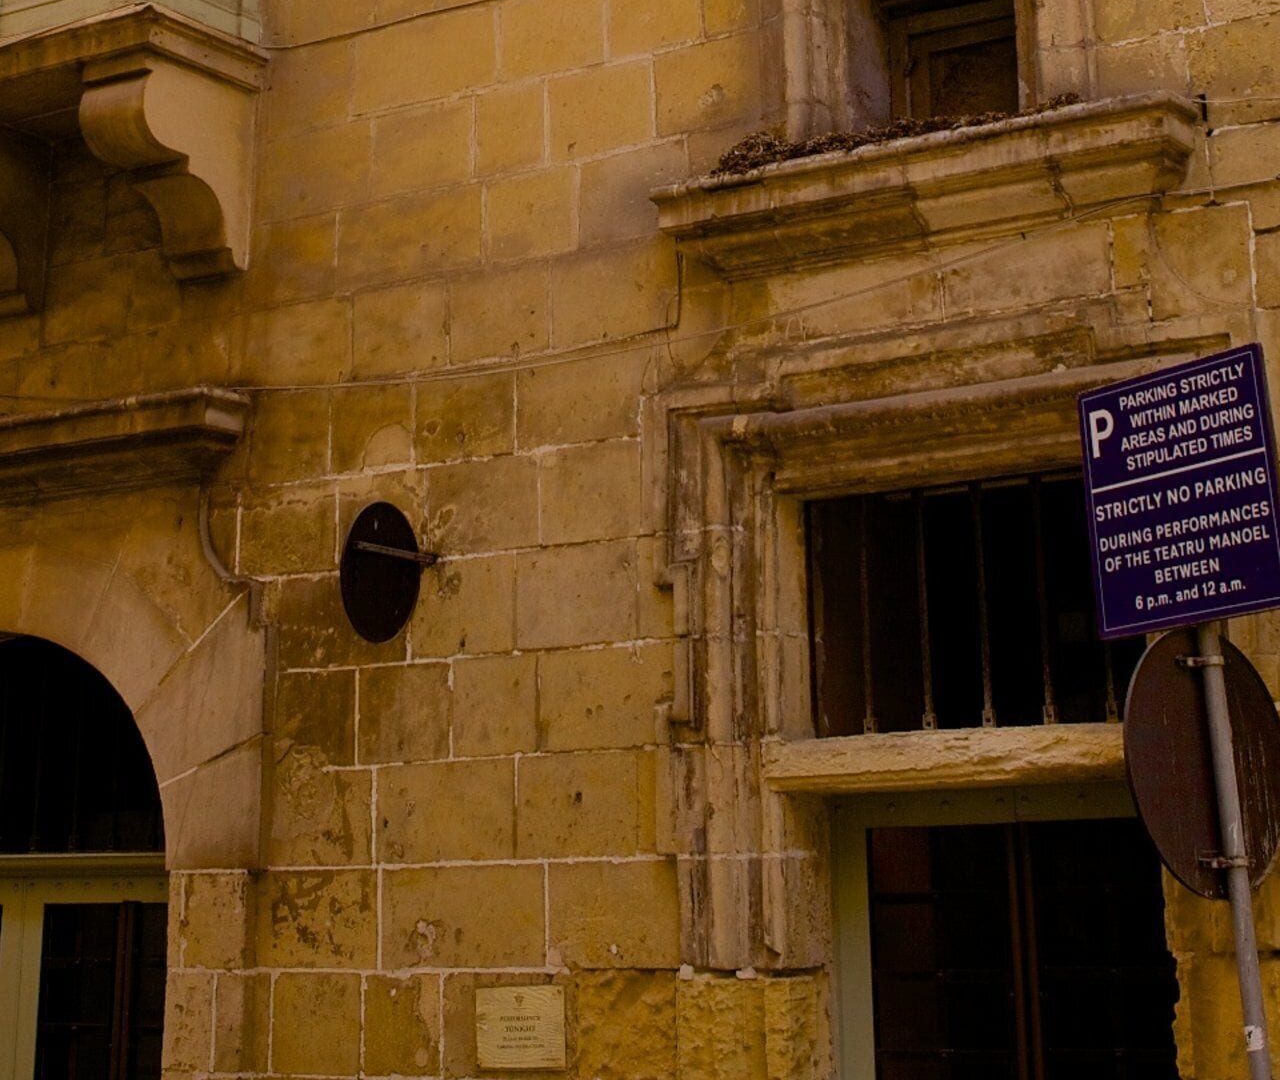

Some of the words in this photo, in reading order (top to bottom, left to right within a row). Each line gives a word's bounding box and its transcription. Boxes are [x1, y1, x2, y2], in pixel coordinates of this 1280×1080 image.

[1119, 382, 1177, 411] PARKING
[1180, 362, 1245, 394] STRICTLY
[1130, 401, 1176, 428] WITHIN
[1179, 387, 1238, 416] MARKED
[1089, 409, 1114, 459] P
[1121, 430, 1166, 452] AREAS
[1168, 422, 1197, 439] AND
[1201, 404, 1254, 431] DURING
[1126, 437, 1208, 471] STIPULATED
[1210, 426, 1253, 449] TIMES
[1095, 492, 1162, 522] STRICTLY
[1167, 486, 1190, 506] NO
[1195, 468, 1266, 499] PARKING
[1100, 528, 1152, 552] DURING
[1156, 501, 1270, 538] PERFORMANCES
[1104, 556, 1122, 573] OF
[1125, 549, 1151, 567] THE
[1154, 538, 1205, 564] TEATRU
[1209, 524, 1270, 550] MANOEL
[1135, 595, 1144, 610] 6
[1147, 594, 1173, 611] p.m.
[1176, 586, 1199, 603] and
[1202, 581, 1215, 596] 12
[1219, 578, 1246, 594] a.m.
[1155, 558, 1220, 584] BETWEEN
